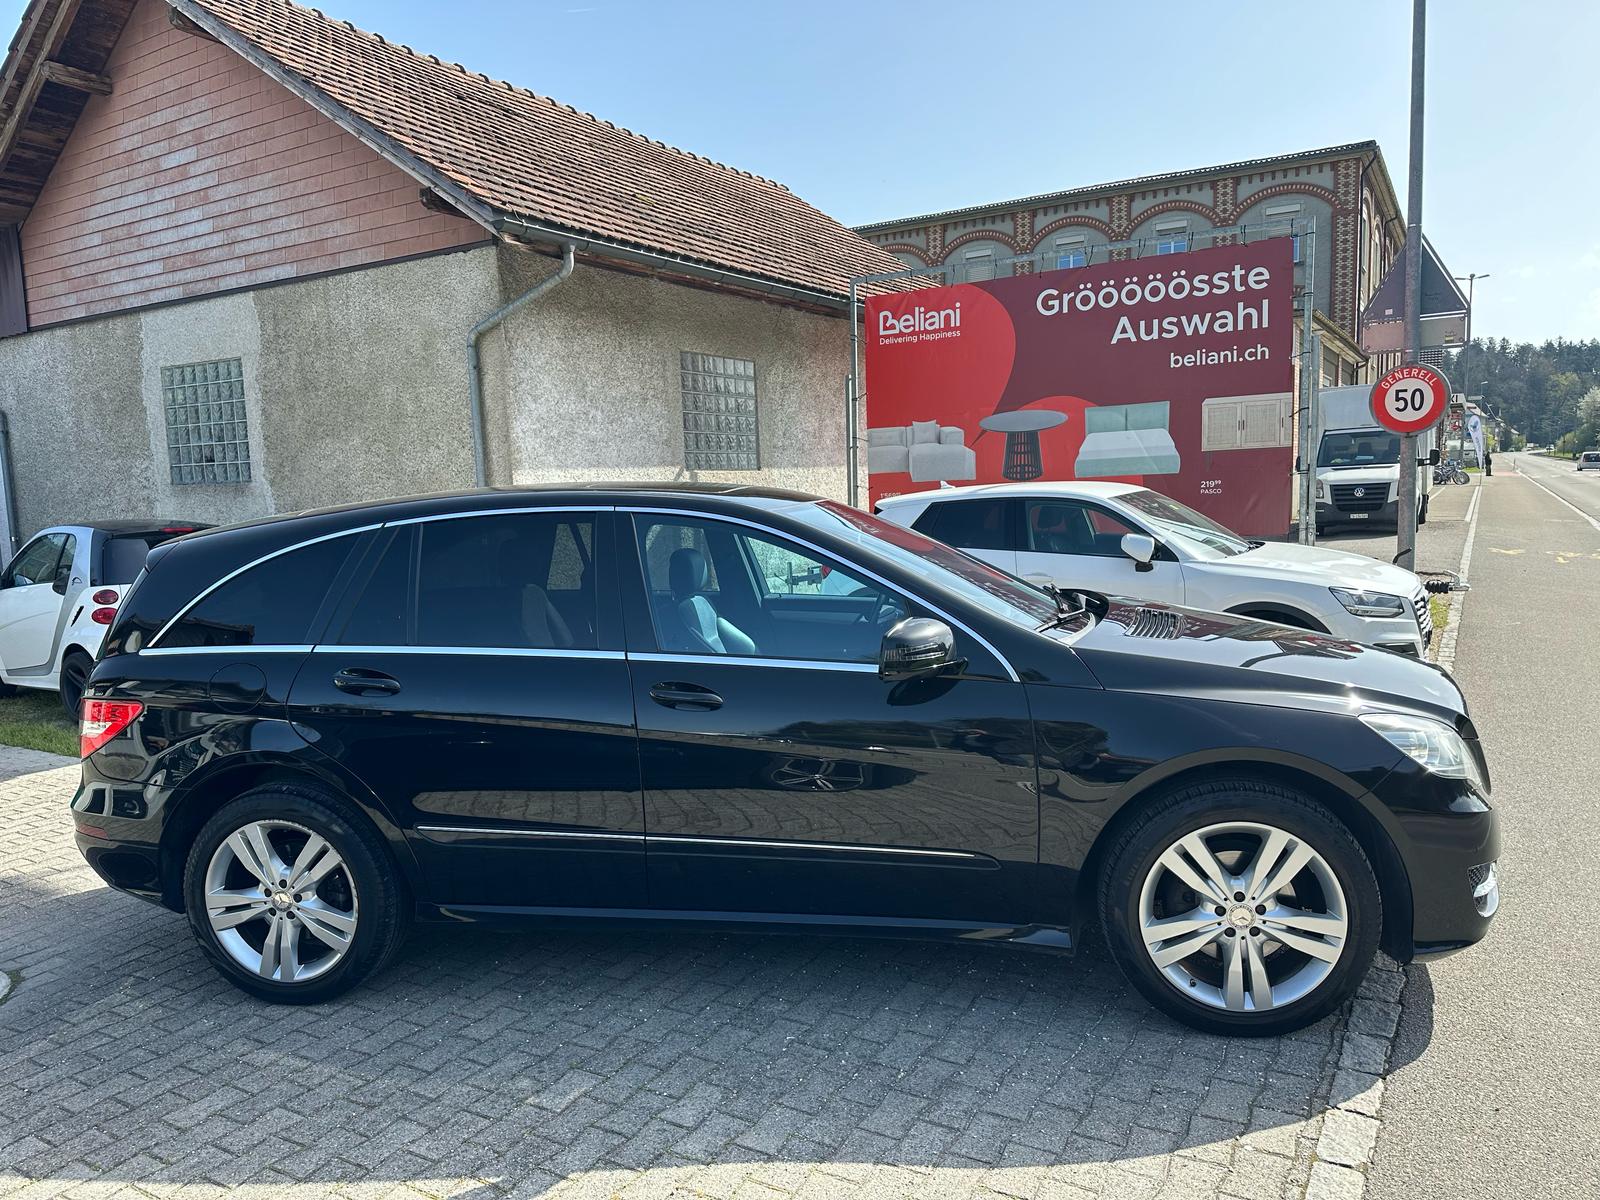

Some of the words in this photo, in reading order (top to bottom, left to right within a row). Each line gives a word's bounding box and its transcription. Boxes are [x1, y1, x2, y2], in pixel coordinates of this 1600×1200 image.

[1036, 264, 1271, 316] Grööööösste
[879, 302, 961, 336] Beliani
[1110, 298, 1269, 345] Auswahl
[879, 334, 918, 346] Delivering
[919, 330, 961, 341] Happiness
[1170, 344, 1270, 368] beliani.ch
[1381, 368, 1438, 389] GENERELL
[1394, 387, 1425, 412] 50
